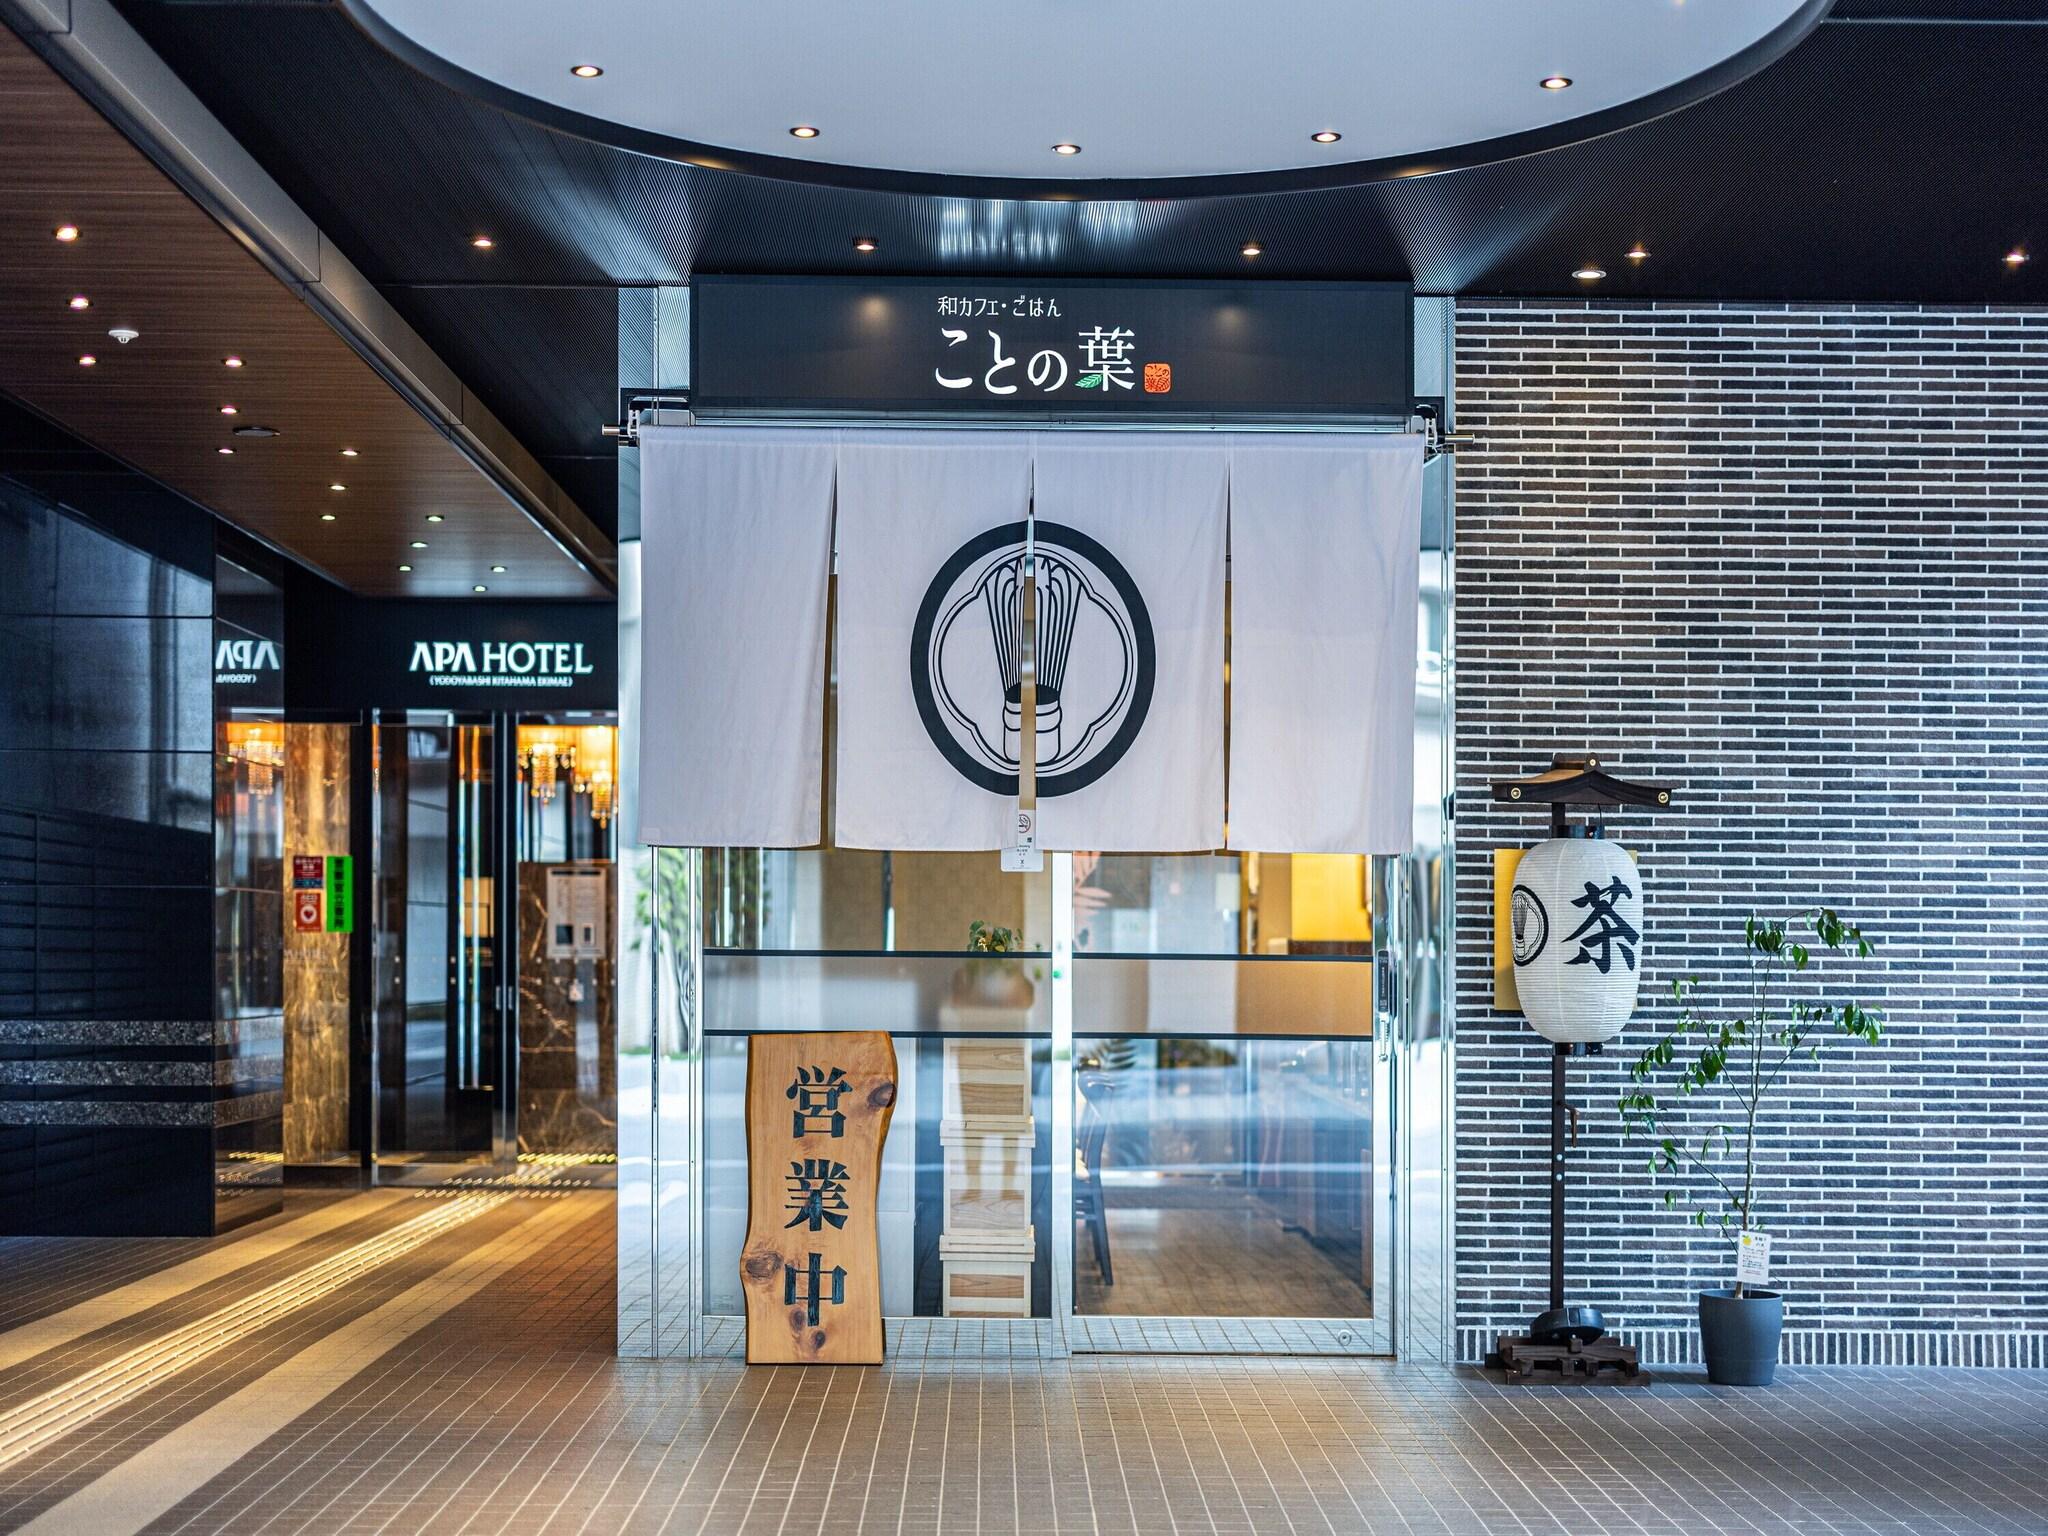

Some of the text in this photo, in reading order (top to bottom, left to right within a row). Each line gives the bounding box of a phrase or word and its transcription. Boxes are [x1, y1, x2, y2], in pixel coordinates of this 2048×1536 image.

[935, 326, 1136, 395] ことの葉
[409, 642, 594, 674] APA HOTEL
[1561, 875, 1640, 974] 茶
[784, 1064, 853, 1327] 営業中
